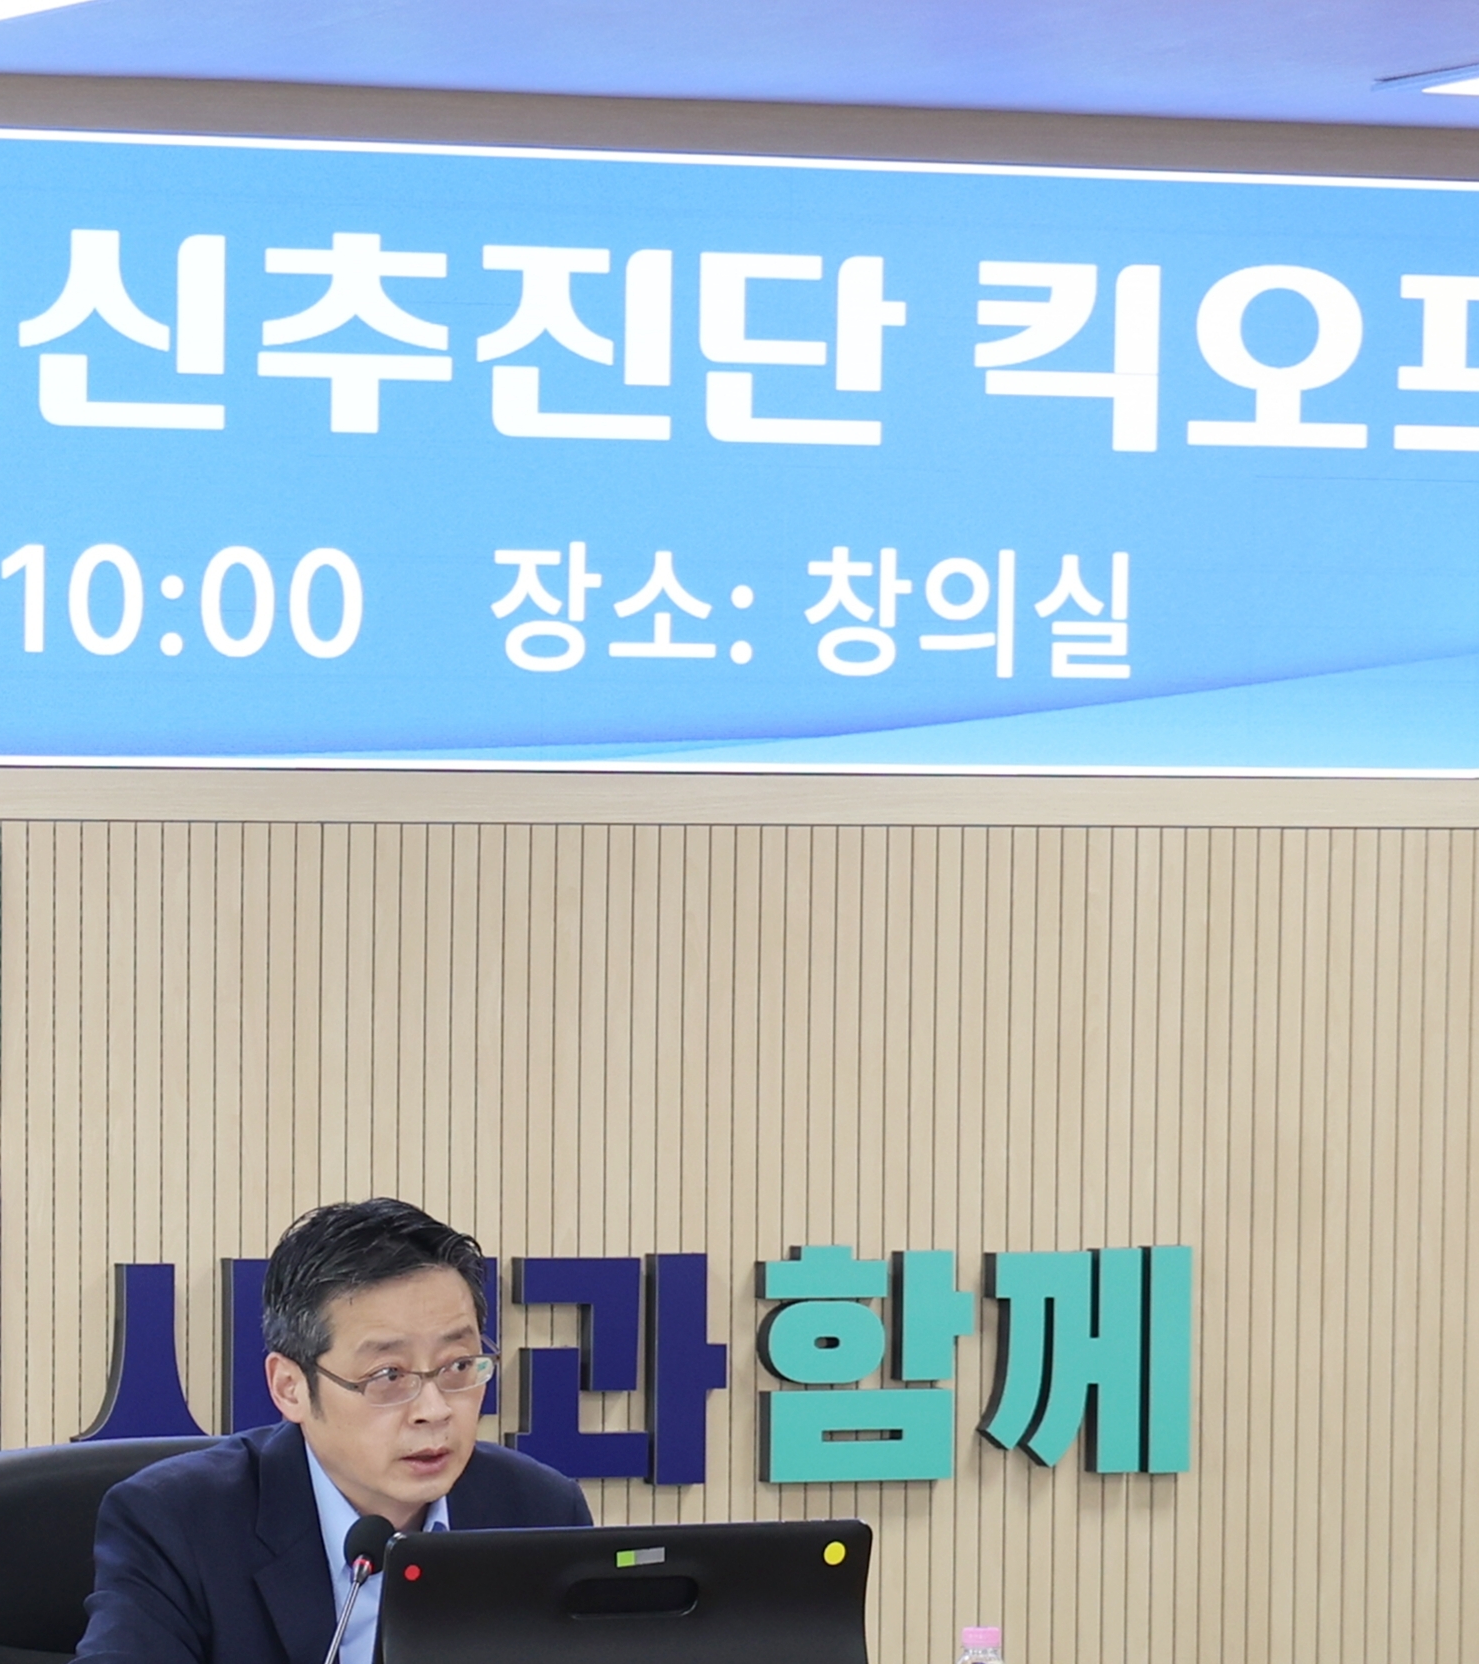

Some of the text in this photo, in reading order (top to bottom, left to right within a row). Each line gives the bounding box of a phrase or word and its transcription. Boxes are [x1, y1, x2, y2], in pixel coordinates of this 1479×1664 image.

[1, 543, 364, 659] 10:00
[490, 540, 755, 673] 장소:
[804, 545, 1132, 680] 창의실
[71, 1253, 727, 1486] 시과
[757, 1244, 1194, 1483] 함께
